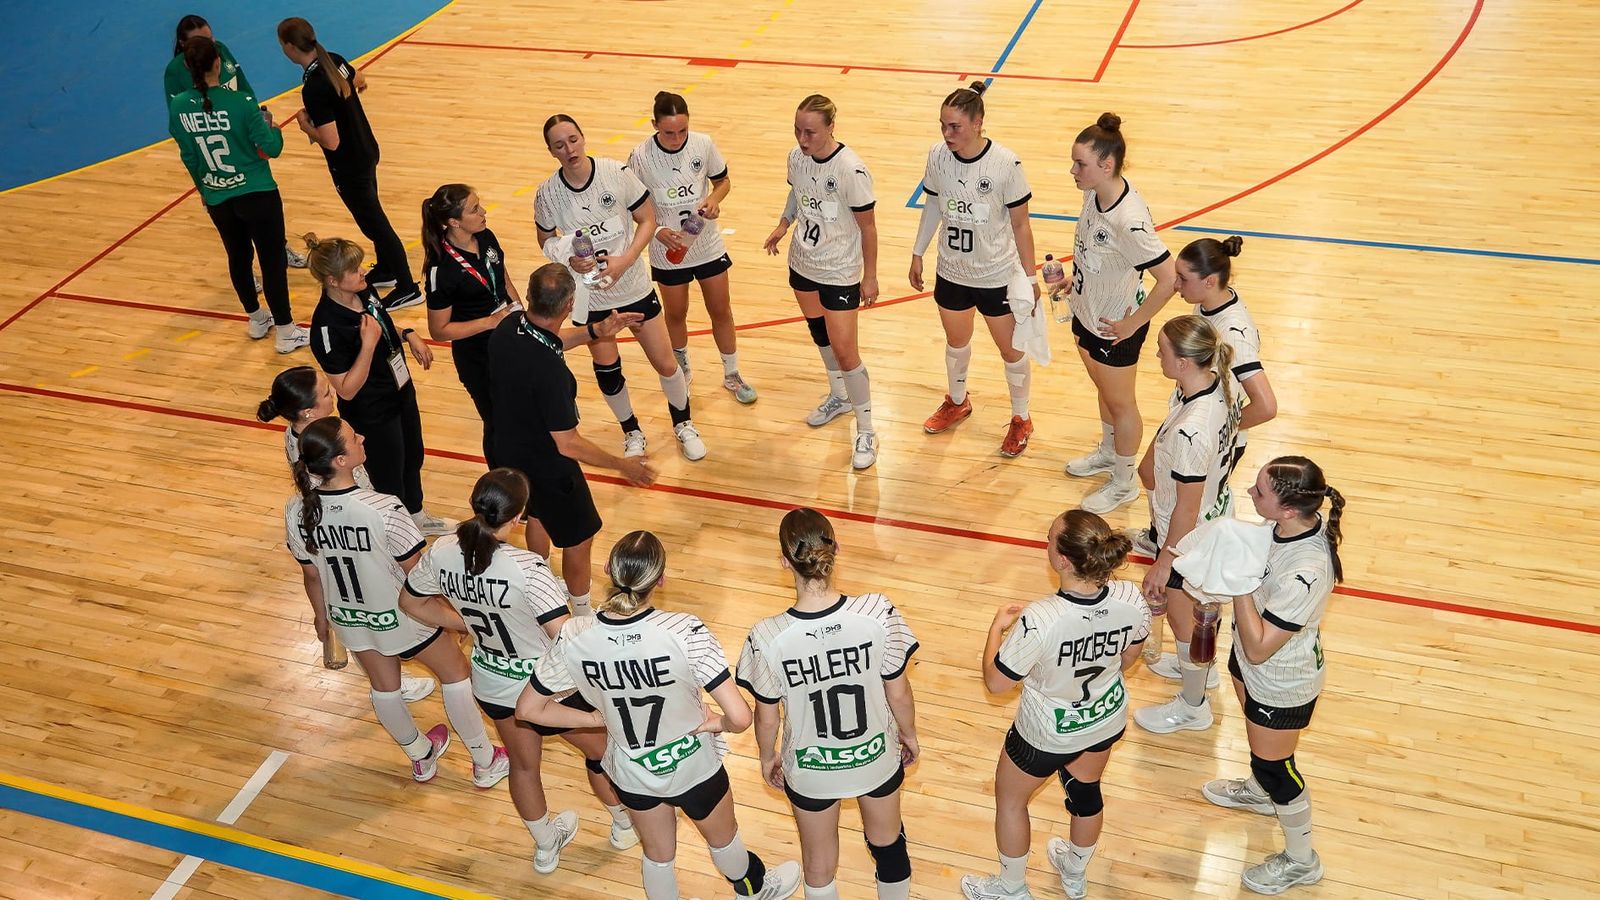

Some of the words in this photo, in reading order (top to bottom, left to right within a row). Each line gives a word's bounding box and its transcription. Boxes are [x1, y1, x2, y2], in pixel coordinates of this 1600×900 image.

[180, 111, 231, 133] WEISS
[195, 134, 236, 173] 12
[202, 173, 245, 187] ALSCO
[667, 184, 694, 199] eak
[801, 195, 822, 212] eak
[947, 199, 973, 214] eak
[803, 219, 820, 247] 14
[947, 226, 974, 253] 20
[326, 556, 364, 604] 11
[439, 568, 512, 609] GAUBATZ
[331, 606, 395, 626] ALSCO
[460, 607, 519, 658] 21
[1057, 625, 1133, 667] PROBST
[581, 655, 676, 691] RUWE
[781, 641, 873, 688] EHLERT
[1072, 666, 1106, 708] 7
[612, 695, 666, 750] 17
[808, 684, 868, 740] 10
[1059, 685, 1122, 727] ALSCO
[643, 735, 695, 770] LSCO
[799, 737, 882, 764] ALSCO
